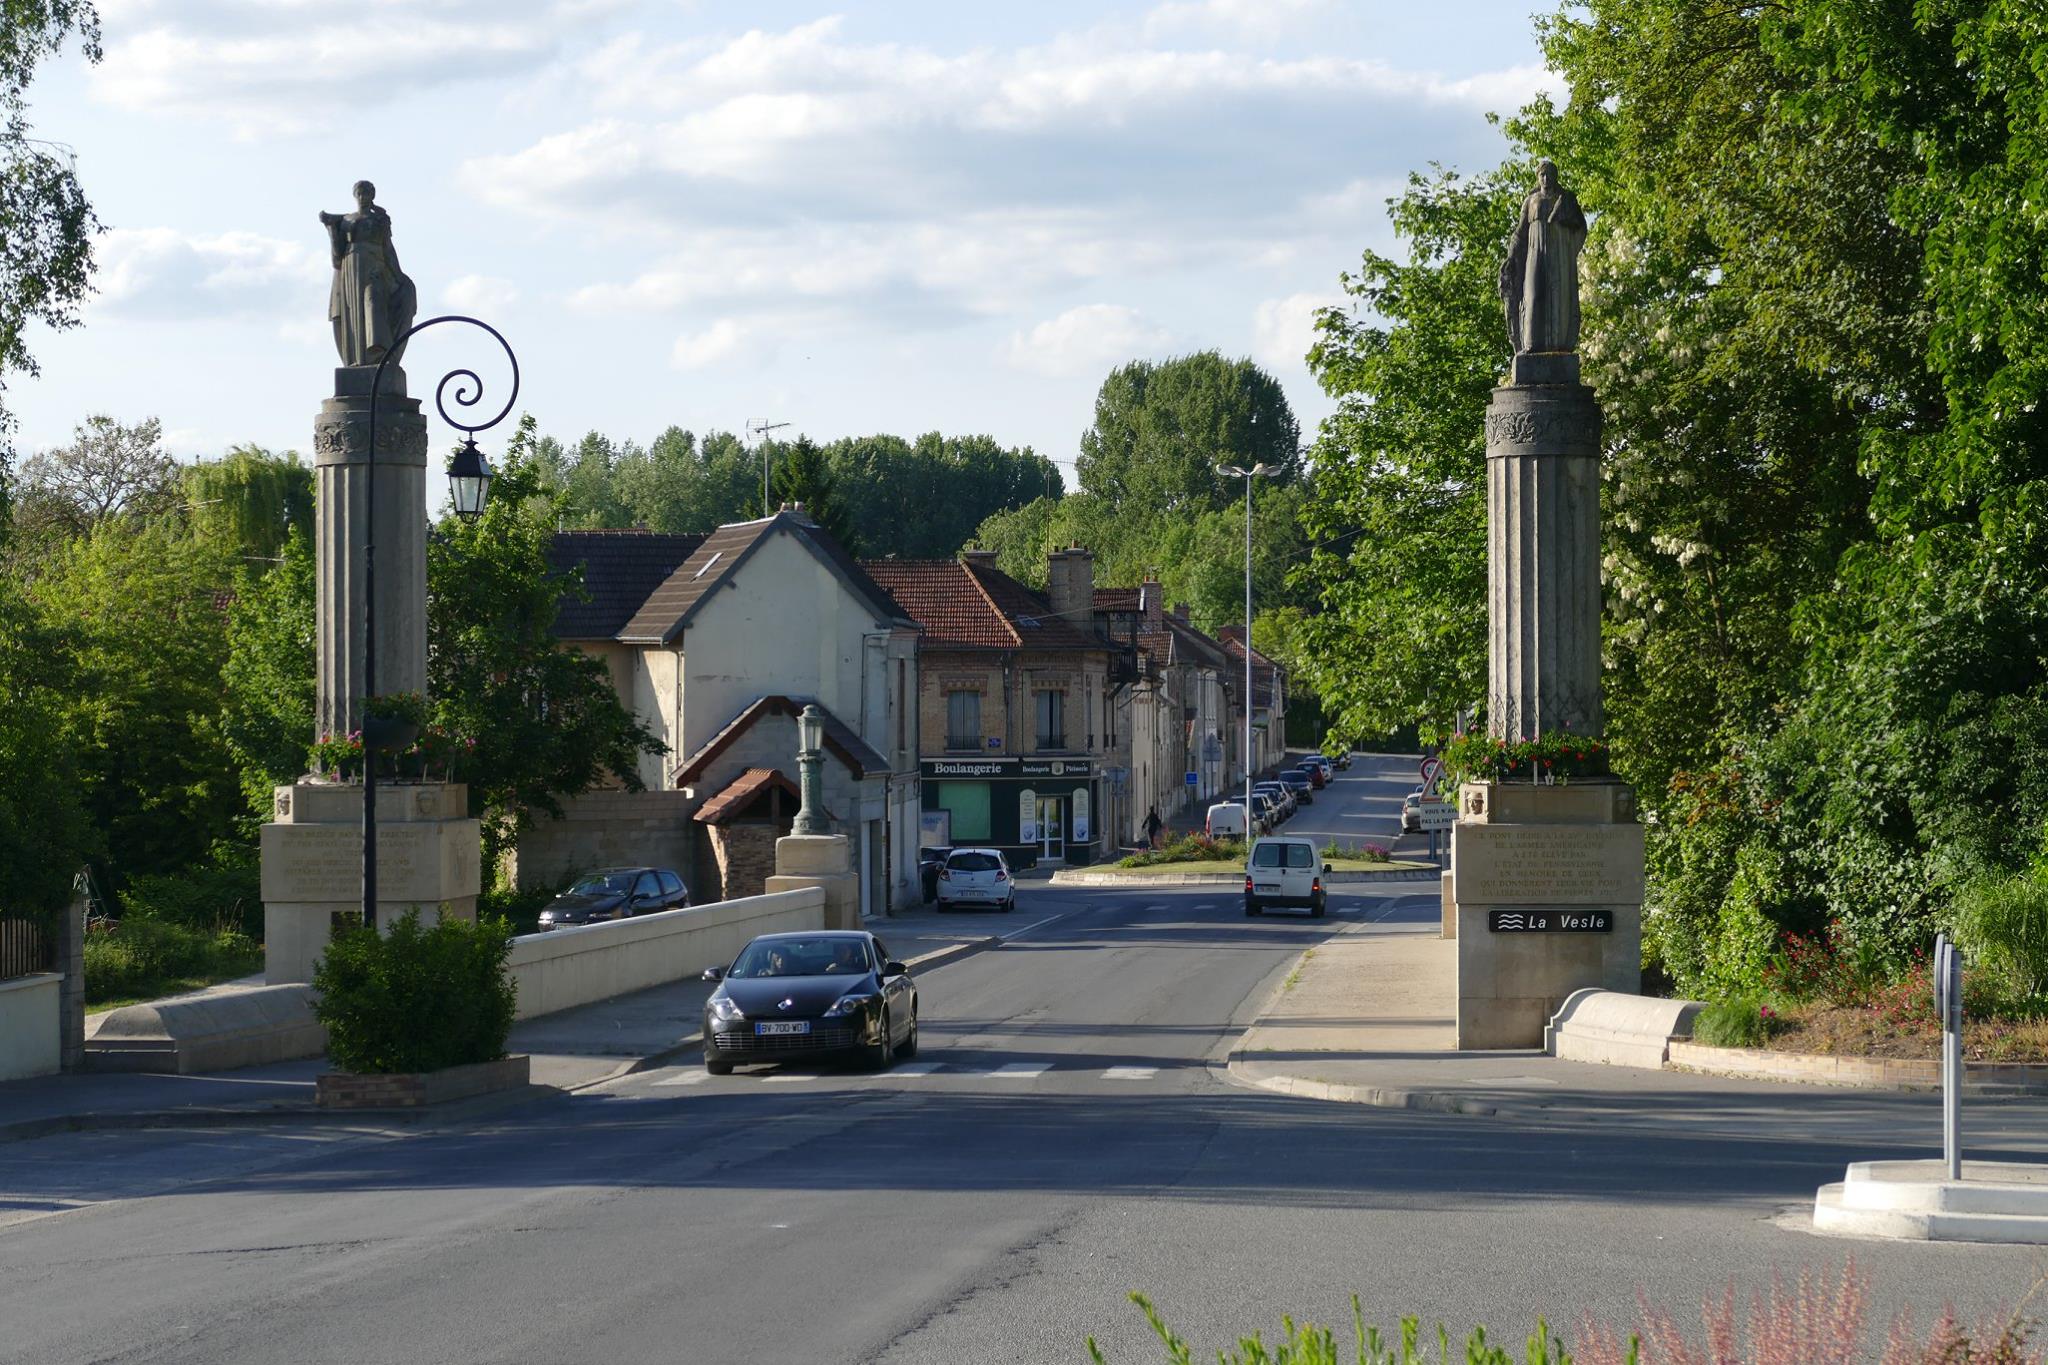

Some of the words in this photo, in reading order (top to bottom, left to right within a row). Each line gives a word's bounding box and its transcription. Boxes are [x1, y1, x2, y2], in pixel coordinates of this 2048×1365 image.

[934, 762, 1002, 776] Boulangerie
[1022, 765, 1050, 774] Boulangerie
[1489, 832, 1511, 840] PONT
[1480, 880, 1497, 888] QUI
[1598, 879, 1622, 888] POUR
[1528, 915, 1547, 929] La
[1560, 914, 1605, 928] Vesle
